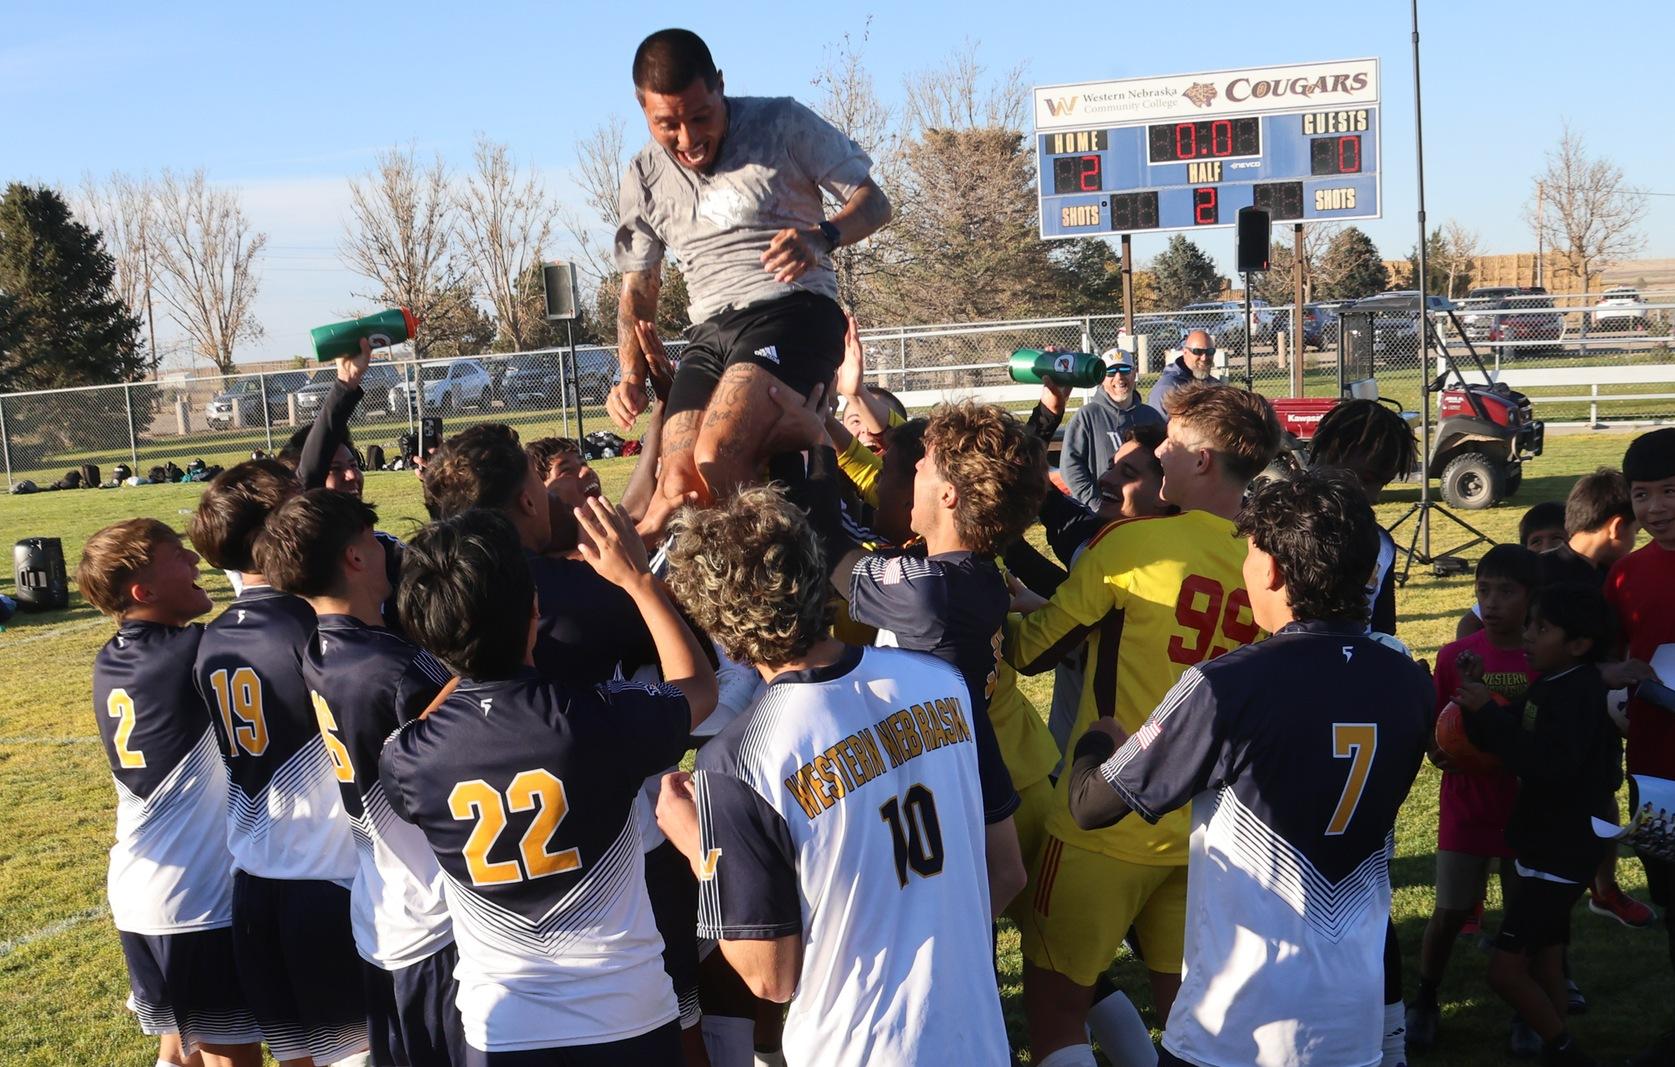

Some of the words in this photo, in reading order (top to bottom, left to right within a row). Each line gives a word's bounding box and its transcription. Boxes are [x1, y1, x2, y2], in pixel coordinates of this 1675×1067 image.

[1083, 91, 1125, 103] Western
[1128, 87, 1178, 99] Nebraska
[1084, 101, 1139, 114] Community
[1142, 98, 1178, 110] College
[1303, 110, 1368, 135] GUESTS
[1054, 130, 1099, 154] HOME
[1338, 135, 1359, 174] 0
[1080, 155, 1099, 191] 2
[1188, 161, 1221, 184] HALF
[1062, 205, 1099, 227] SHOTS
[1196, 187, 1216, 224] 2
[1315, 188, 1356, 211] SHOTS
[106, 688, 147, 769] 2
[210, 666, 270, 757] 19
[784, 728, 887, 820] WESTERN
[873, 696, 973, 769] NEBRASK
[1324, 722, 1378, 836] 7
[447, 766, 582, 886] 22
[879, 783, 945, 890] 10
